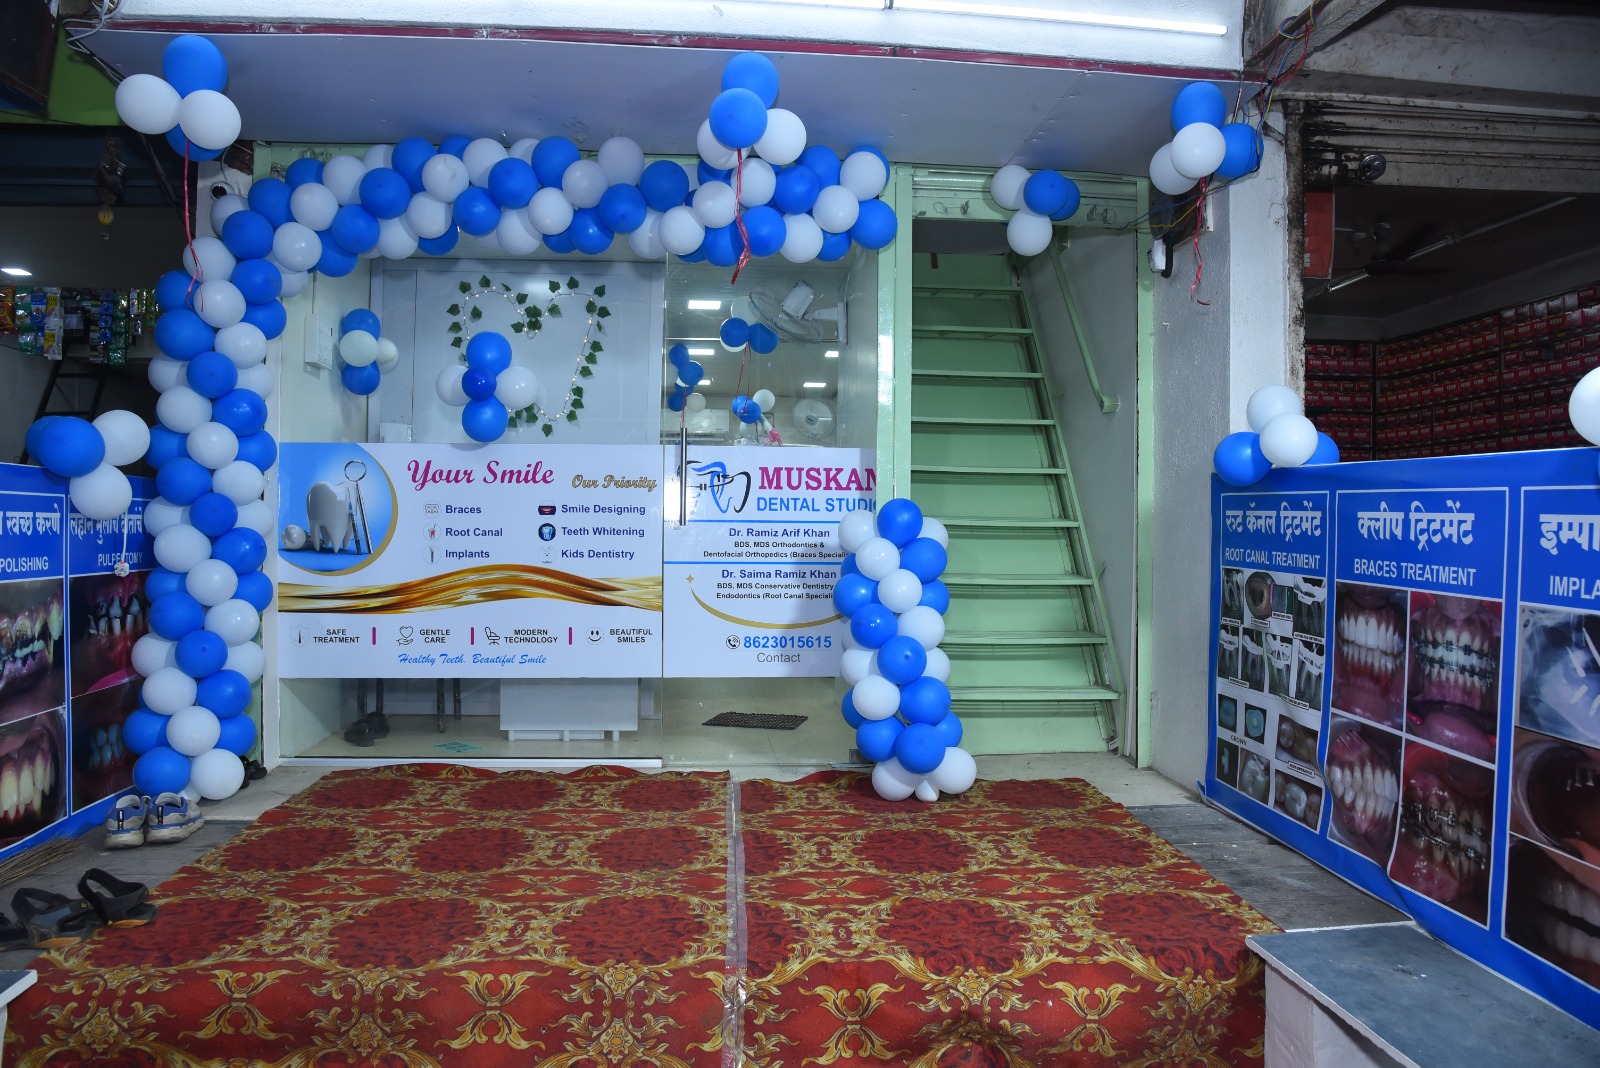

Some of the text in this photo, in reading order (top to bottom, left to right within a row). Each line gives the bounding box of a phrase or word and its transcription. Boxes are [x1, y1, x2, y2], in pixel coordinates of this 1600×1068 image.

[407, 459, 555, 491] Your Smile
[759, 466, 876, 491] MUSKAN
[571, 474, 657, 492] Our Priority
[445, 504, 482, 514] Braces
[561, 503, 646, 516] Smile Designing
[757, 497, 876, 512] DENTAL STUDI
[6, 512, 34, 536] स्वच्छ
[36, 503, 60, 536] करणे
[1246, 501, 1276, 534] कॅनल
[445, 527, 503, 537] Root Canal
[561, 527, 645, 538] Teeth Whitening
[1357, 500, 1474, 552] क्लीप ट्रिटमेंट
[729, 528, 830, 538] Dr. Ramiz Arif Khan
[445, 549, 490, 560] Implants
[561, 549, 635, 561] Kids Dentistry
[1226, 548, 1320, 570] ROOT CANAL TREATMENT
[0, 556, 48, 573] POLISHING
[722, 570, 837, 579] Dr. Saima Ramiz Khan
[1354, 558, 1476, 586] BRACES TREATMENT
[1550, 575, 1600, 600] IMPLA
[326, 628, 347, 637] SAFE
[743, 636, 832, 649] 8623015615
[398, 653, 547, 666] Healthy Teeth. Beautiful Smile
[757, 652, 801, 663] Contact
